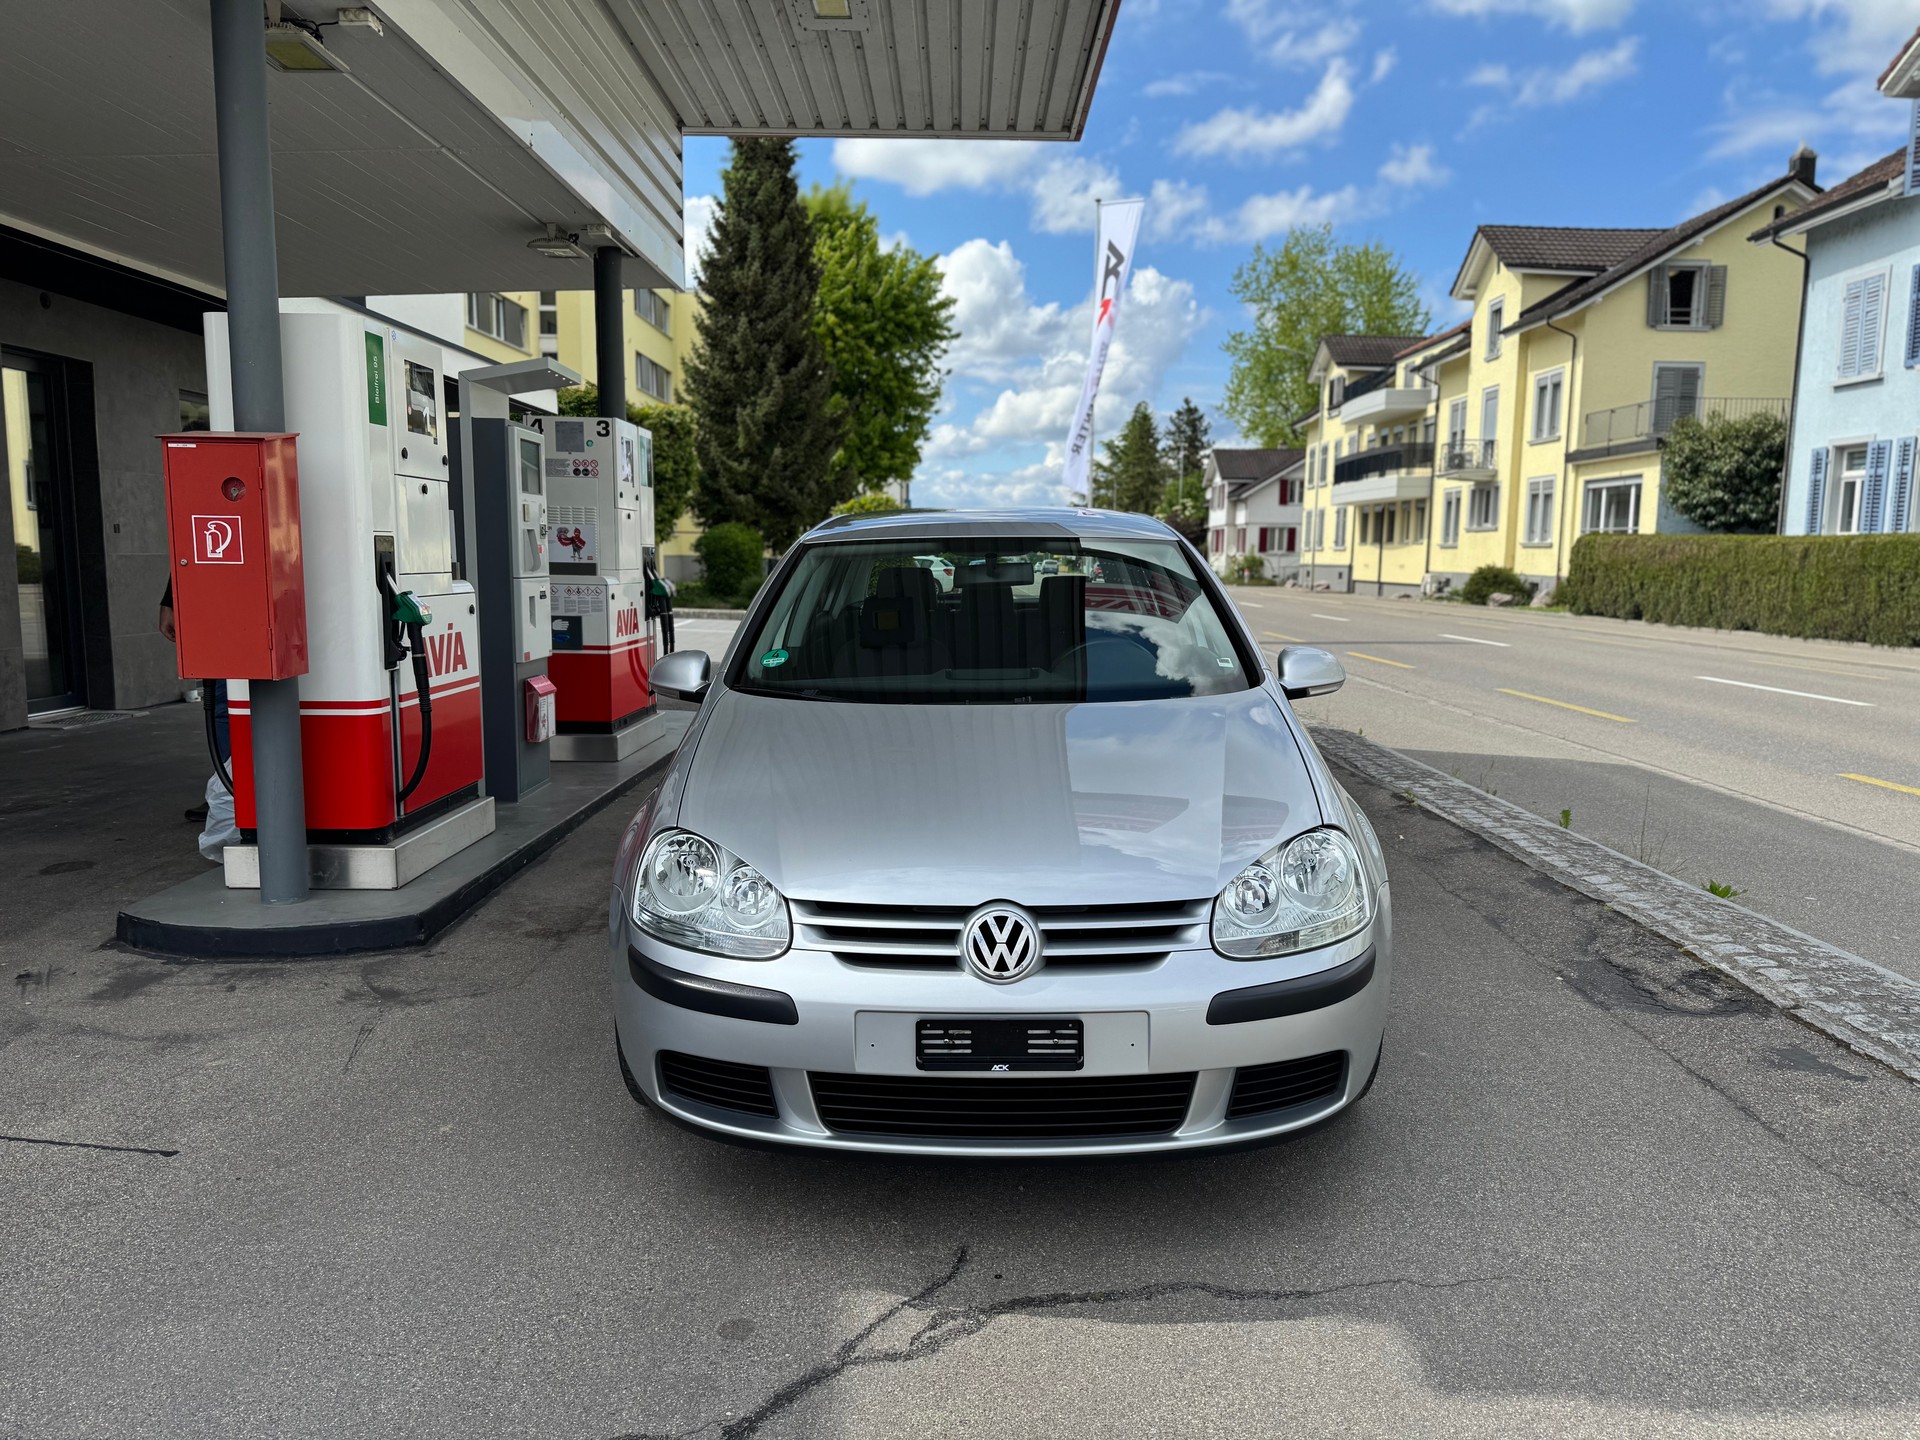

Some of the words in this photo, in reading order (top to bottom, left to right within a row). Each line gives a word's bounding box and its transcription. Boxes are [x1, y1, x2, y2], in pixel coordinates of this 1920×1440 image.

[596, 420, 610, 437] 3
[616, 601, 640, 638] AVIA
[422, 623, 468, 678] VIA
[771, 650, 780, 658] 4
[969, 911, 1035, 976] VW
